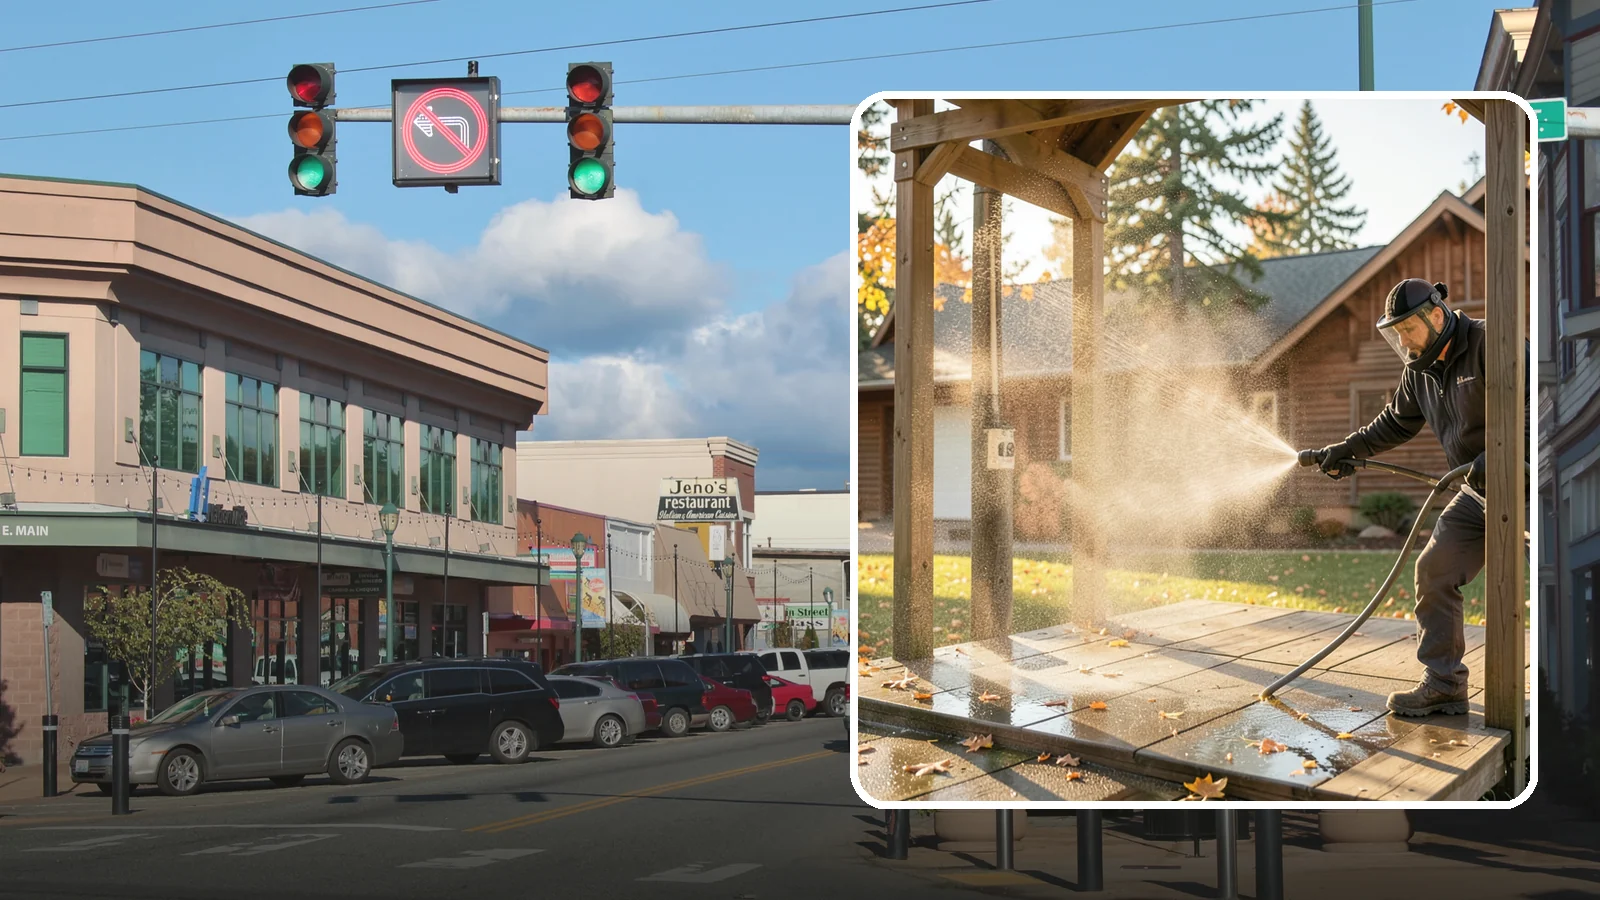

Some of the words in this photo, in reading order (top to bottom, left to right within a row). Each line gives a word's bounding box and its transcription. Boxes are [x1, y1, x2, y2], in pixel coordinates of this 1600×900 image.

[669, 479, 728, 494] Jeno's
[665, 496, 731, 509] restaurant
[658, 509, 682, 519] Italian
[686, 509, 714, 519] American
[715, 509, 738, 519] Cuisine
[2, 525, 13, 536] E.
[15, 525, 49, 536] MAIN
[797, 607, 828, 617] Street
